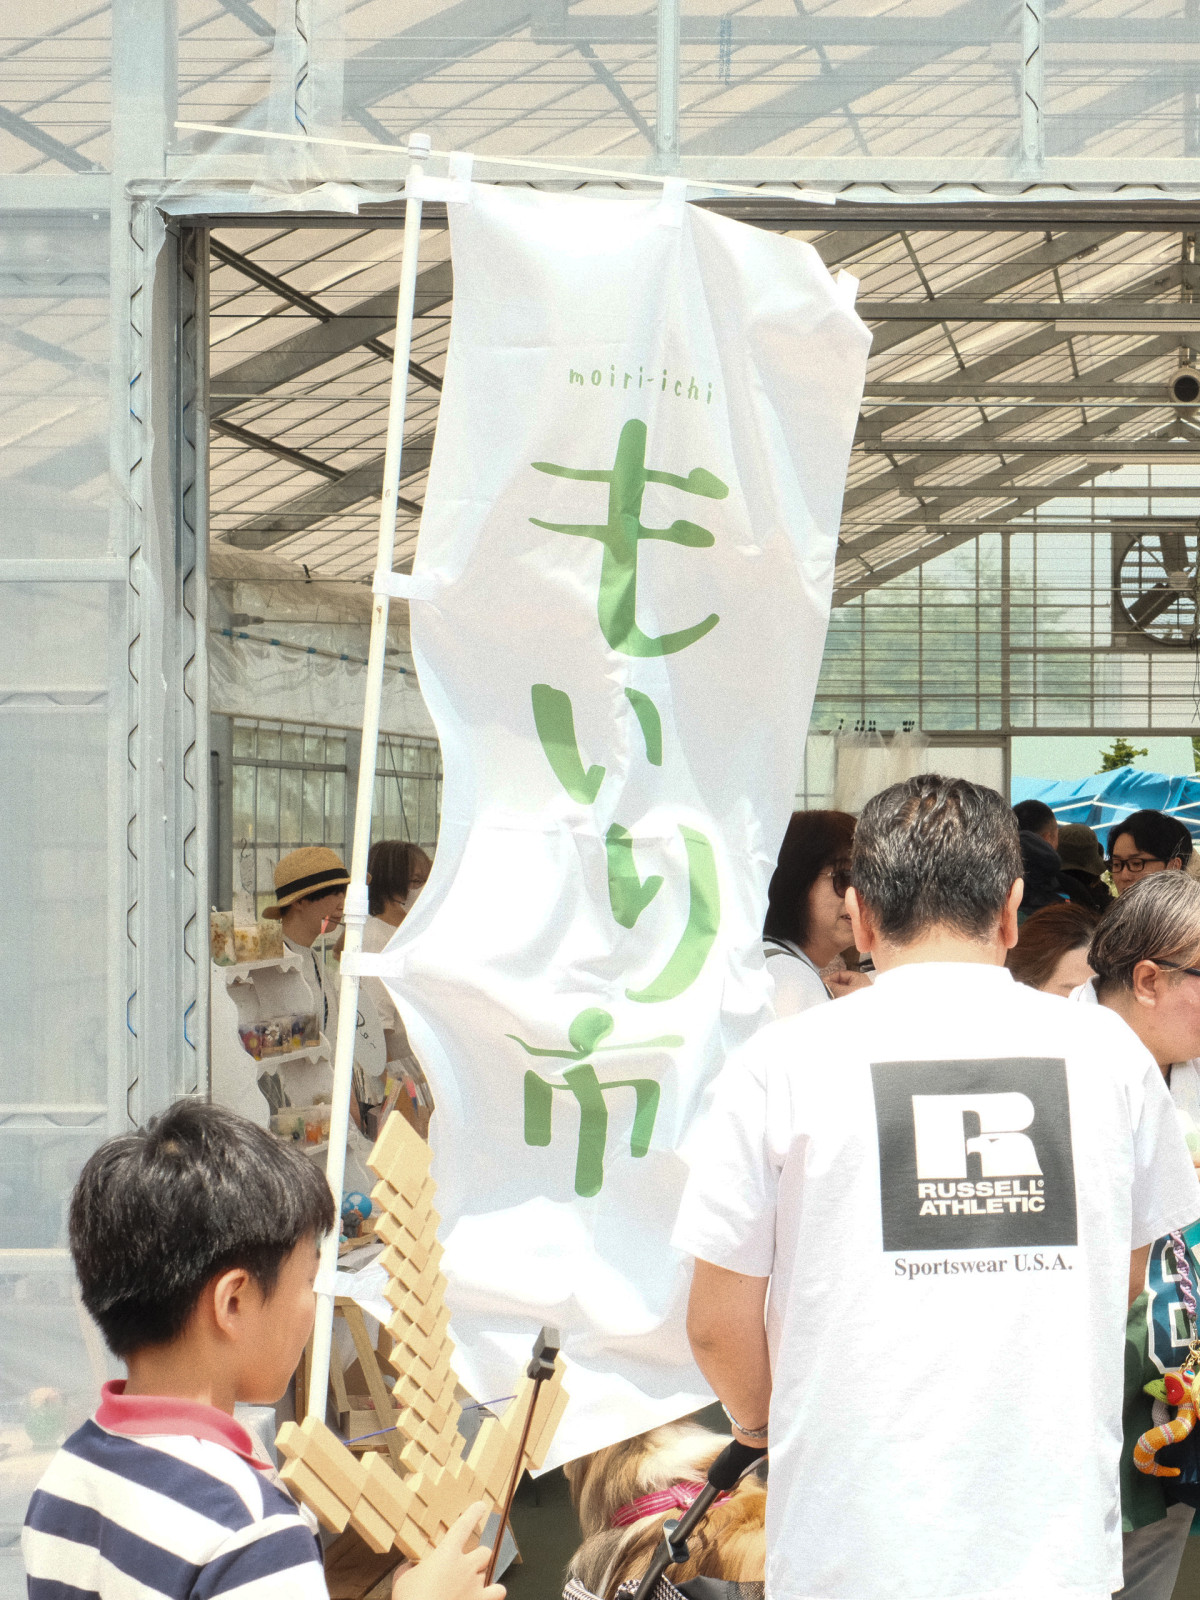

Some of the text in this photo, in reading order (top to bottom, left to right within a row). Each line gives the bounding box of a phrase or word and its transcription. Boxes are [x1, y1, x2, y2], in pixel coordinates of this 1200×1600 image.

[569, 364, 713, 404] moiri-ichi
[505, 418, 730, 1198] もいり市
[917, 1180, 1044, 1199] RUSSELL
[919, 1197, 1045, 1216] ATHLETIC
[894, 1253, 1074, 1280] Sportswear U.S.A.
